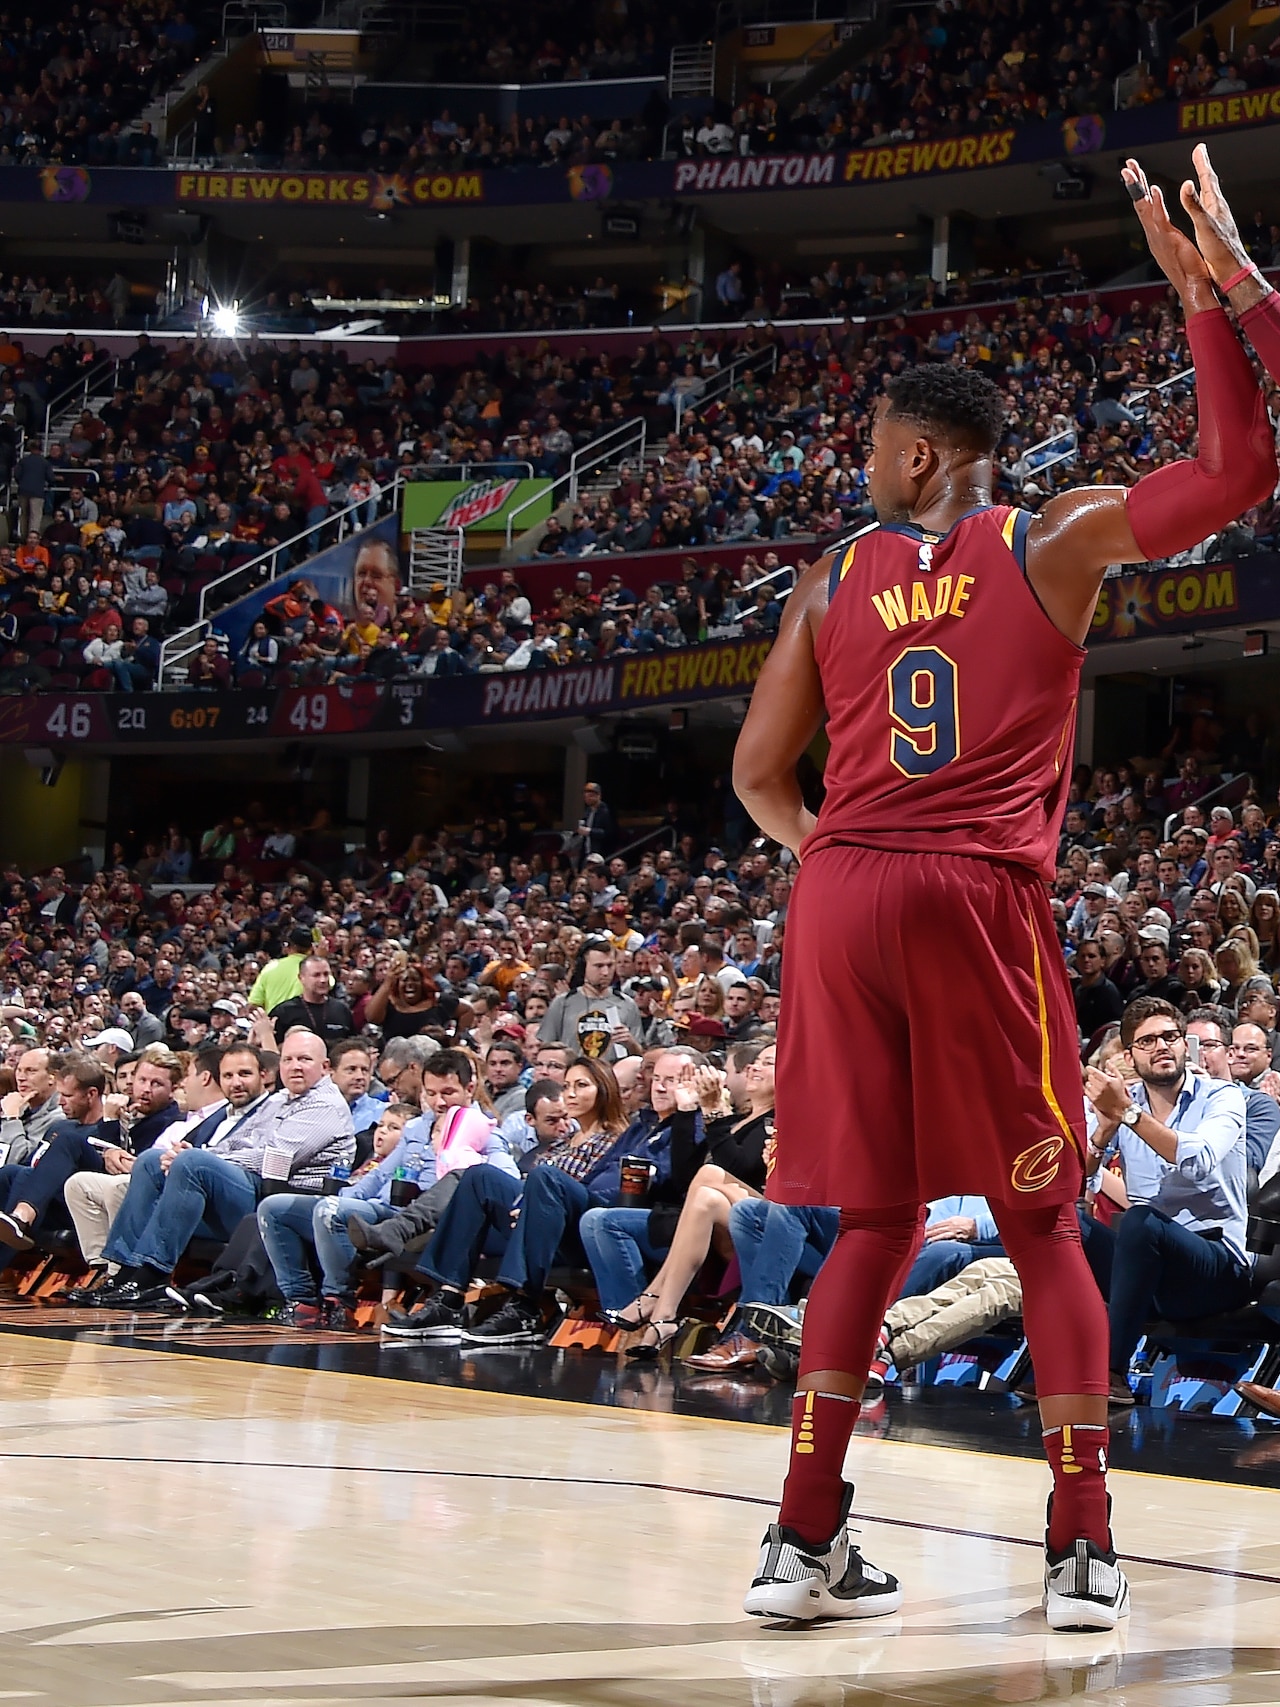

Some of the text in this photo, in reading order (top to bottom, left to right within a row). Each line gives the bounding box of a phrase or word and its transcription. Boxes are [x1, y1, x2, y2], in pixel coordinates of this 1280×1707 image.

[266, 35, 288, 49] 214
[179, 175, 482, 200] FIREWORKS COM
[674, 131, 1016, 191] PHANTOM FIREWORKS
[871, 573, 975, 632] WADE
[1157, 569, 1235, 616] COM
[484, 641, 771, 715] PHANTOM FIREWORKS
[46, 703, 92, 738] 46
[170, 707, 221, 729] 6:07
[246, 705, 269, 724] 24
[289, 694, 328, 731] 49
[399, 698, 414, 725] 3
[887, 645, 961, 780] 9
